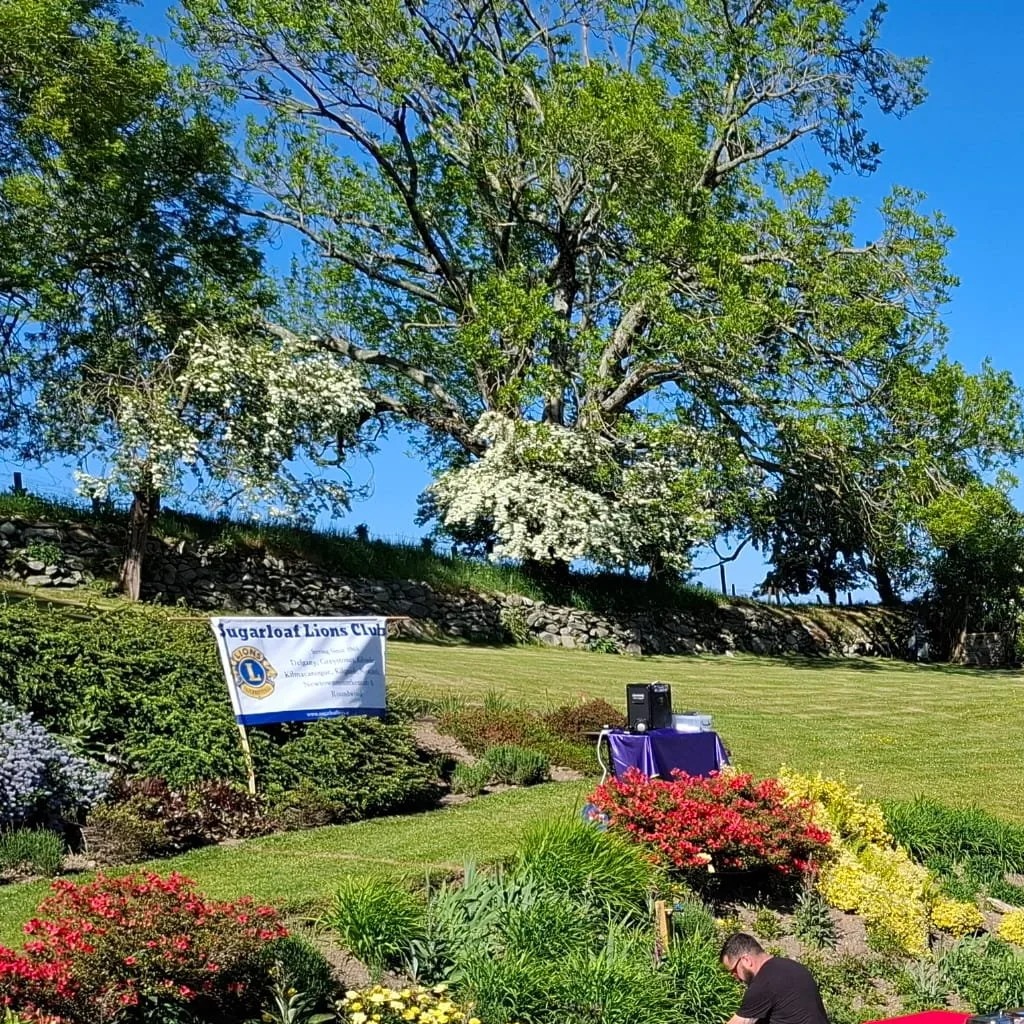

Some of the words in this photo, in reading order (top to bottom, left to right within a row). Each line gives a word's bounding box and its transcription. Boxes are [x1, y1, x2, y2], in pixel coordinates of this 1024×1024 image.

[218, 623, 300, 641] Sugarloaf
[303, 623, 348, 637] Lions
[351, 623, 386, 637] Club
[234, 647, 261, 659] LIONS
[244, 663, 262, 681] L
